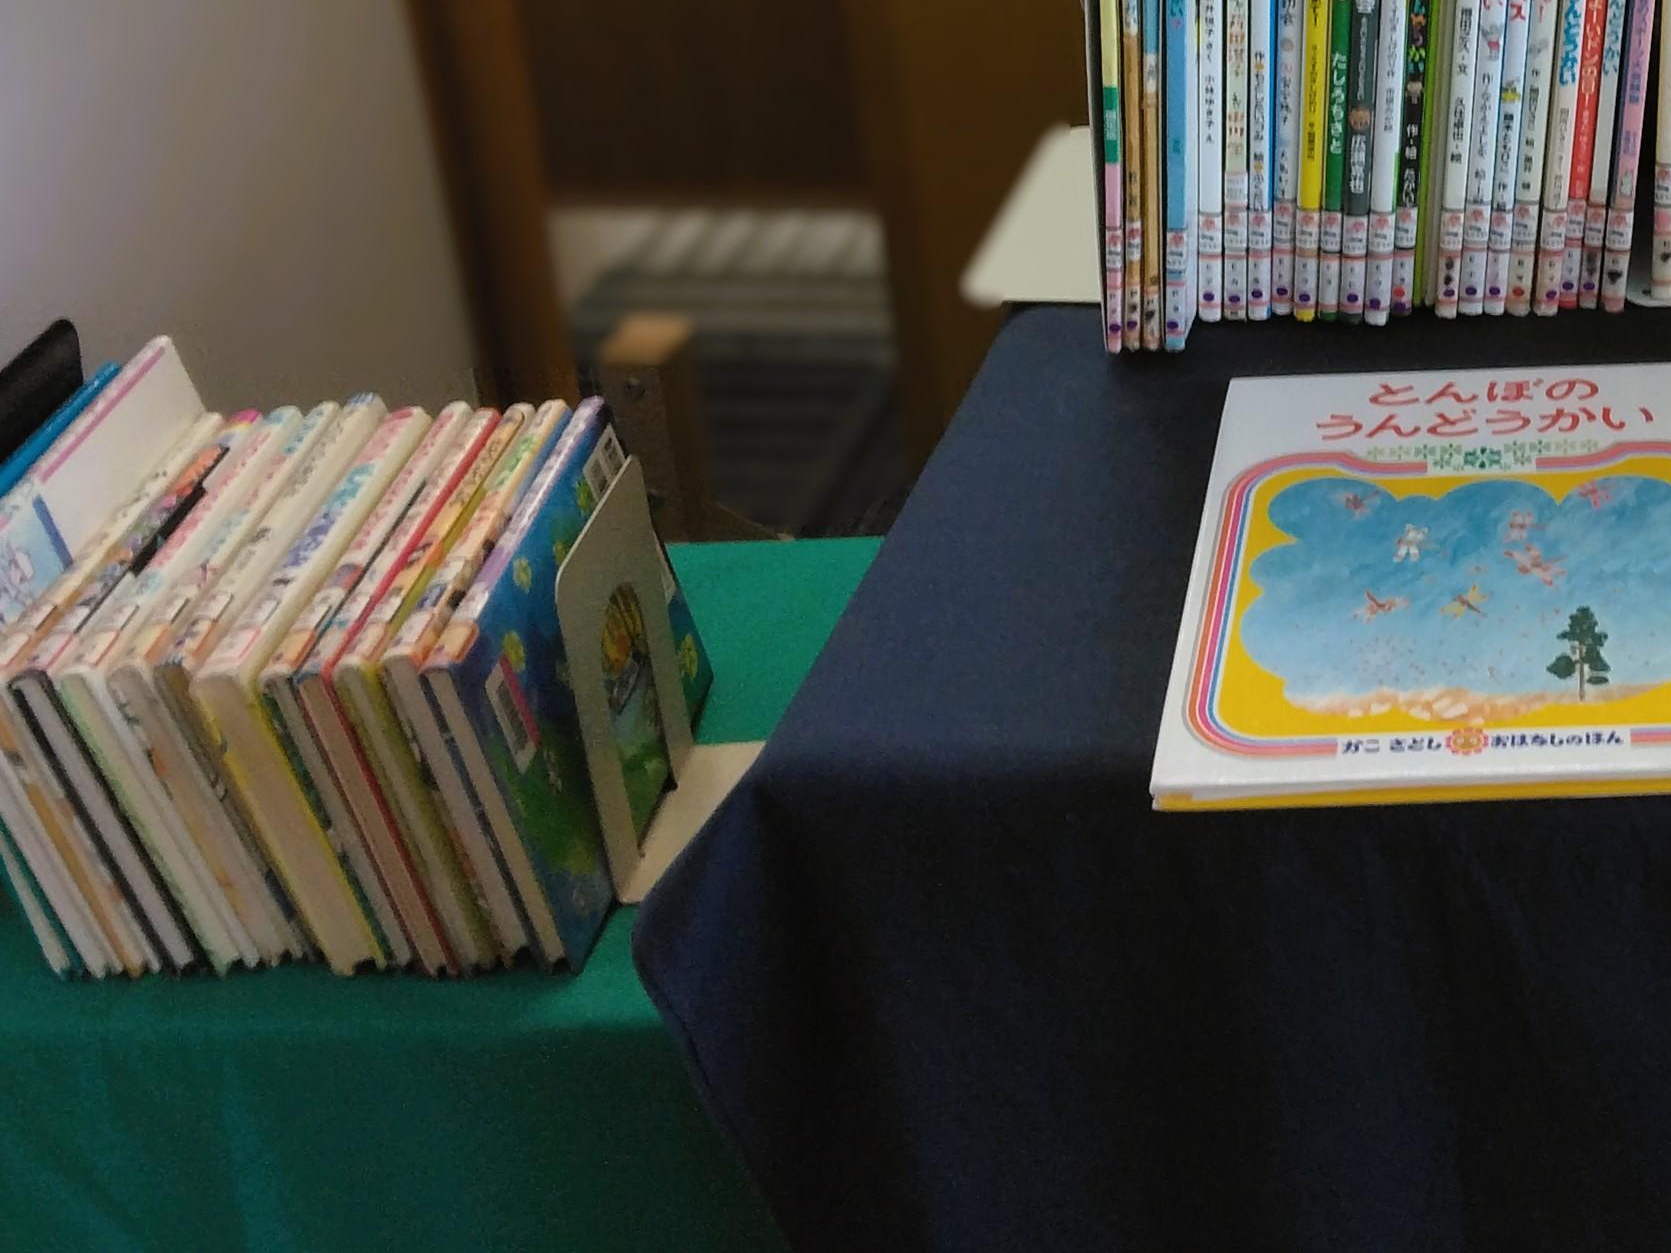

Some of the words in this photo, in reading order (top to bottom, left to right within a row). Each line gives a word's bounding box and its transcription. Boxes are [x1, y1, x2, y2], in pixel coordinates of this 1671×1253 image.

[1370, 378, 1600, 407] とんぼの
[1315, 406, 1655, 441] うんどうかい
